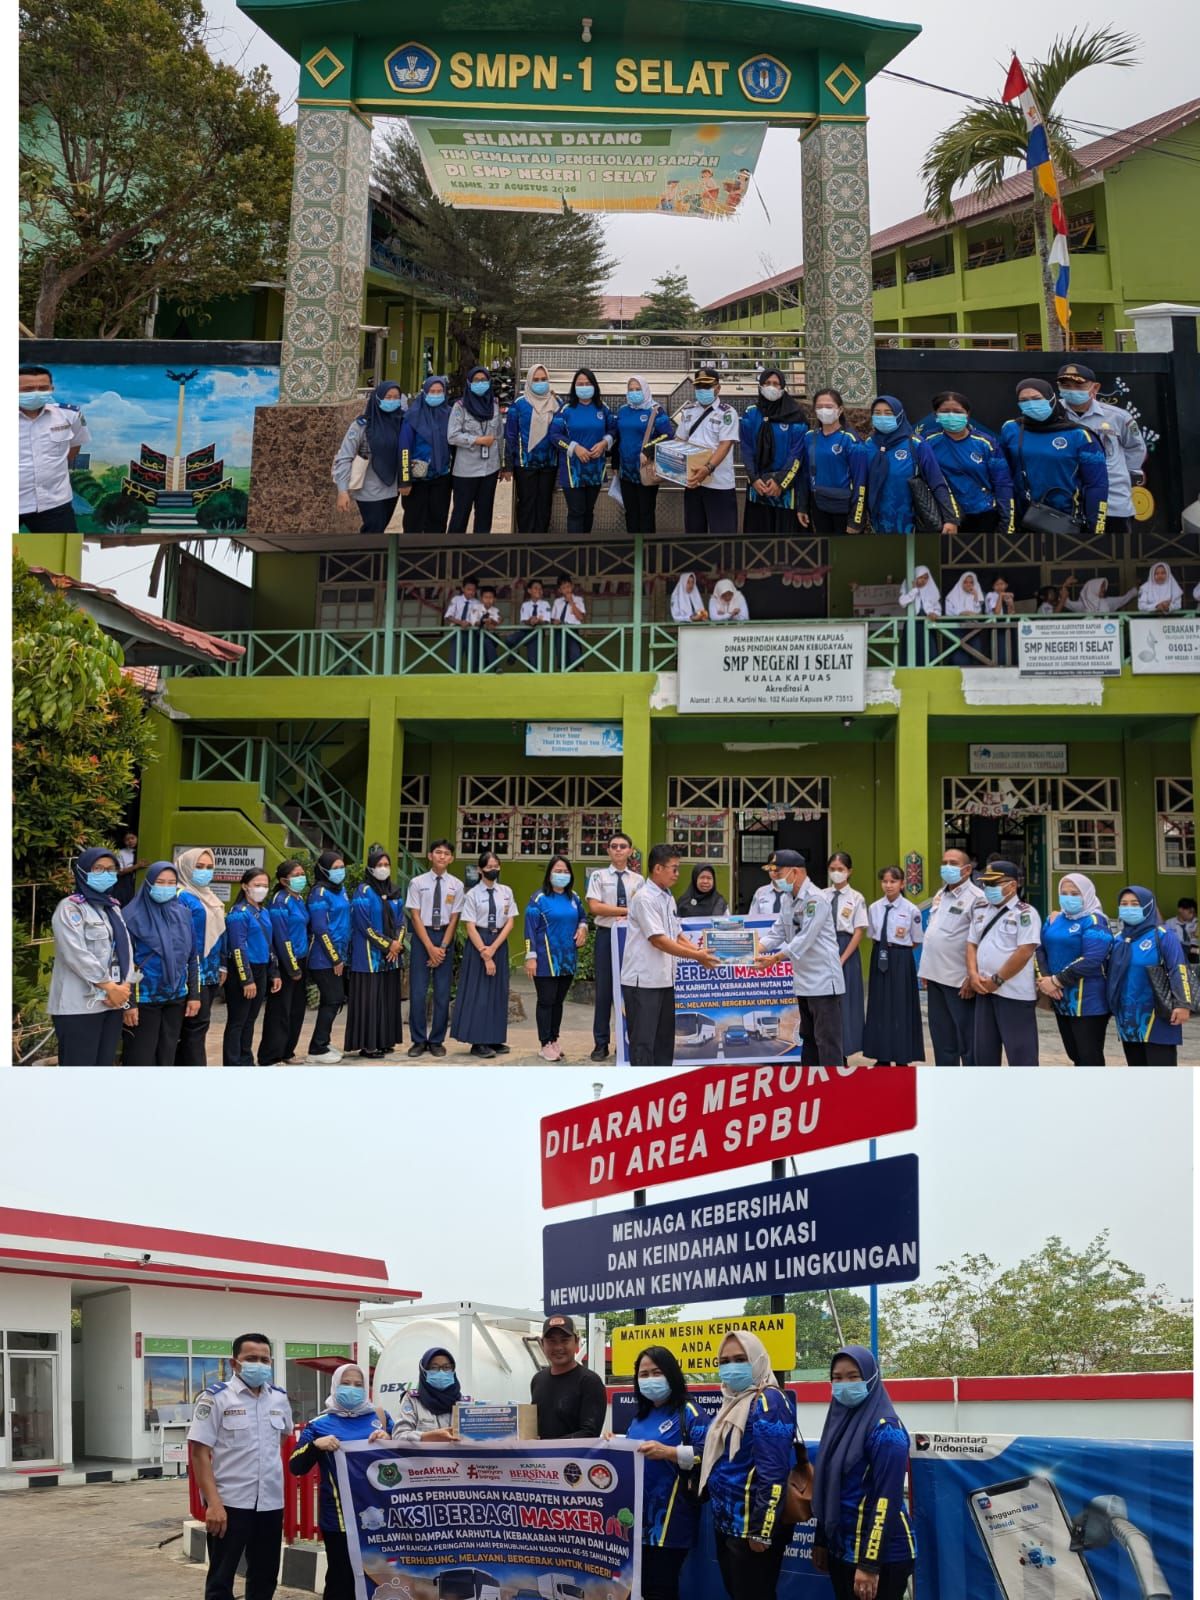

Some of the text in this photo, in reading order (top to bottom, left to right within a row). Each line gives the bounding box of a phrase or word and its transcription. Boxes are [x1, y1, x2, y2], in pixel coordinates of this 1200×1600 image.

[450, 51, 730, 96] SMPN-1 SELAT
[463, 132, 642, 146] SELAMAT DATANG
[439, 149, 720, 168] TIM PEMANTAU PENGELOLAAN SAMPAH
[445, 164, 656, 184] DI SMP NEGERI 1 SELAT
[488, 182, 499, 190] 27
[504, 183, 548, 192] AGUSTUS
[1162, 624, 1194, 633] GERAKAN
[733, 633, 844, 643] PEMERINTAH KABUPATEN KAPUAS
[1024, 640, 1113, 653] SMP NEGERI 1 SELAT
[724, 645, 745, 653] DINAS
[747, 644, 788, 652] PENDIDIKAN
[722, 653, 853, 672] SMP NEGERI 1 SELAT
[744, 673, 831, 683] KUALA KAPUAS
[765, 684, 810, 693] Akreditasi A
[229, 858, 256, 866] ROKOK
[685, 984, 719, 992] KARHUTLA
[545, 1066, 875, 1159] DILARANG MEROK
[589, 1098, 822, 1185] DI AREA SPBU
[612, 1188, 809, 1243] MENJAGA KEBERSIHAN
[607, 1220, 817, 1272] DAN KEINDAHAN LOKASI
[550, 1241, 917, 1307] MEWUJUDKAN KENYAMANAN LINGKUNGAN
[620, 1318, 784, 1341] MATIKAN MESIN KENDARAAN
[681, 1341, 712, 1353] ANDA
[688, 1358, 719, 1369] MENG
[933, 1434, 988, 1444] Danantara
[933, 1444, 984, 1453] Indonesia
[391, 1490, 604, 1508] DINAS PERHUBUNGAN KABUPATEN KAPUAS
[388, 1503, 605, 1535] AKSI BERBAGI MASKER
[761, 1484, 782, 1538] DISHUB
[865, 1497, 888, 1560] DISHUB
[367, 1532, 413, 1545] MELAWAN
[414, 1530, 454, 1542] DAMPAK
[456, 1529, 501, 1540] KARHUTLA
[503, 1530, 557, 1543] (KEBAKARAN
[558, 1535, 587, 1547] HUTAN
[587, 1538, 604, 1549] DAN
[381, 1545, 405, 1553] DALAM
[406, 1544, 433, 1552] RANGKA
[434, 1541, 475, 1551] PERINGATAN
[476, 1541, 492, 1549] HARI
[492, 1542, 539, 1552] PERHUBUNGAN
[539, 1545, 571, 1555] NASIONAL
[589, 1551, 608, 1562] TAHUN
[400, 1555, 457, 1565] TERHUBUNG,
[507, 1554, 555, 1566] BERGERAK
[555, 1559, 583, 1570] UNTUK
